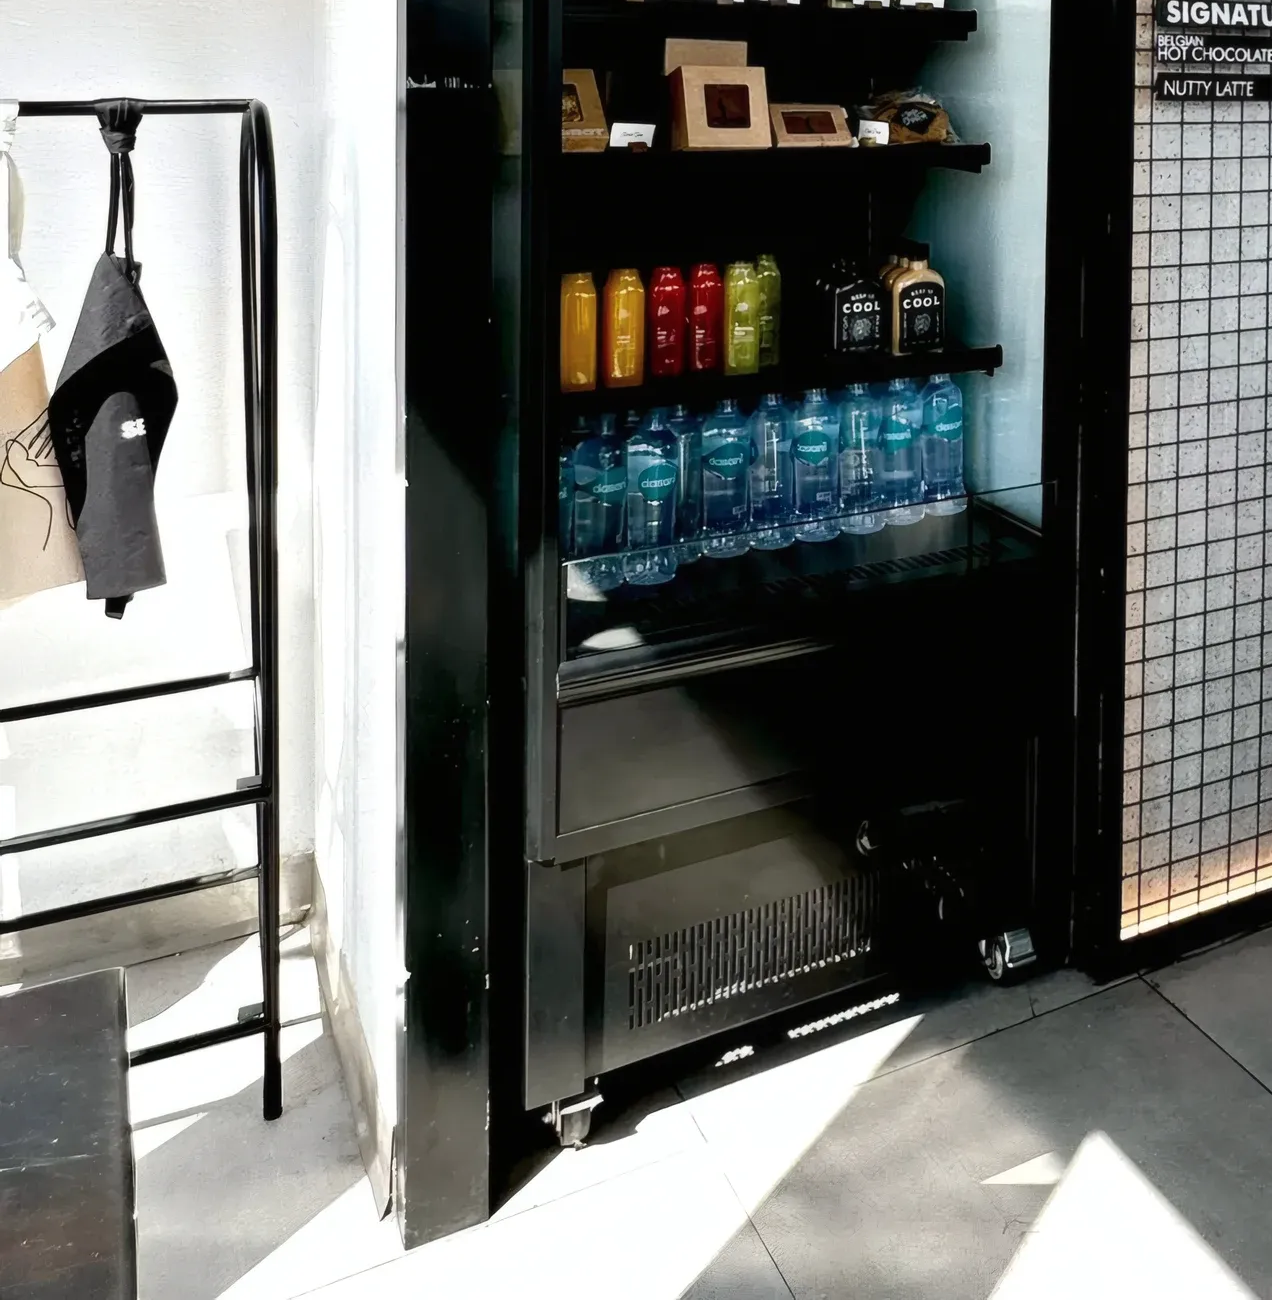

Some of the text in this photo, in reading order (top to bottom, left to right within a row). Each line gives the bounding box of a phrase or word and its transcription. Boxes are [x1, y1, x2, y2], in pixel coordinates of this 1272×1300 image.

[1158, 35, 1204, 47] BELGIAN
[1158, 47, 1187, 61] HOT
[1164, 81, 1211, 97] NUTTY
[1216, 81, 1253, 97] LATTE
[843, 301, 880, 313] COOL
[903, 296, 940, 309] COOL
